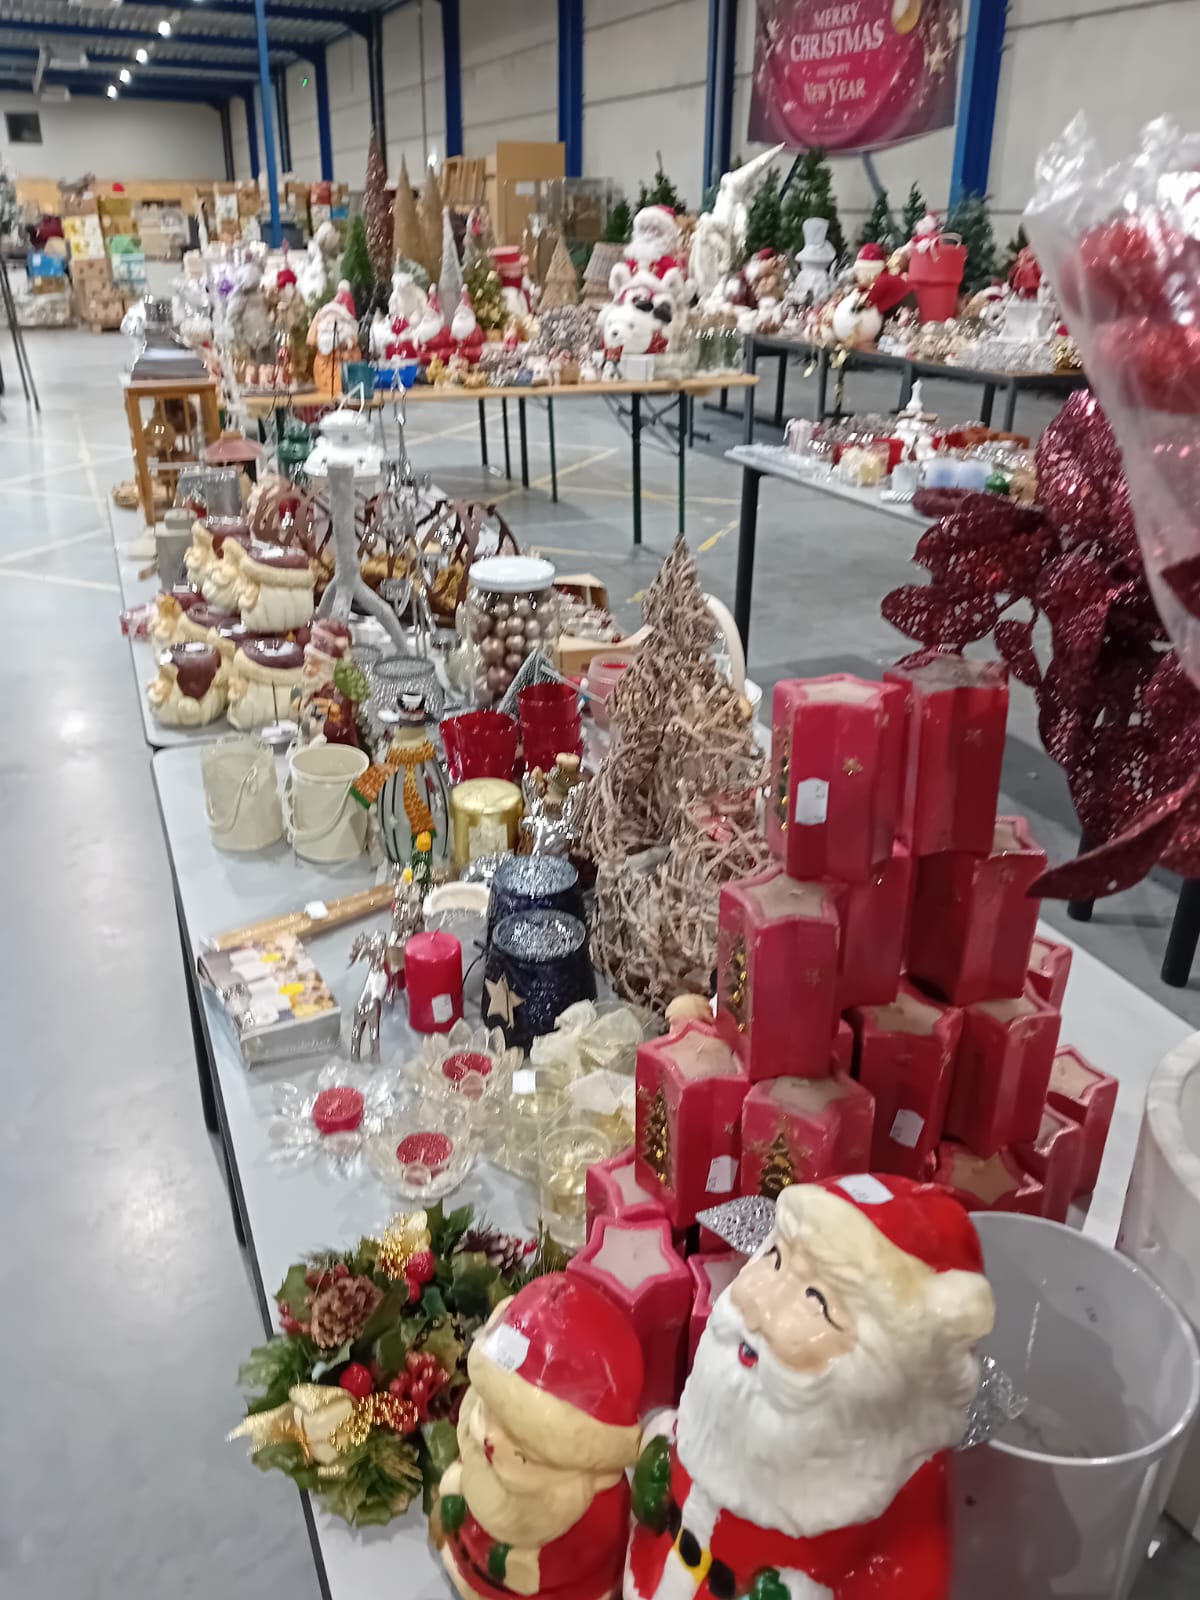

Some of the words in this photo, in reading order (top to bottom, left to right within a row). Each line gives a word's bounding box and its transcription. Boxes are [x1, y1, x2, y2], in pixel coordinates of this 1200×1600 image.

[813, 1, 860, 29] MERRY
[790, 18, 885, 62] CHRISTMAS
[803, 82, 828, 104] NEW
[827, 77, 866, 107] YEAR
